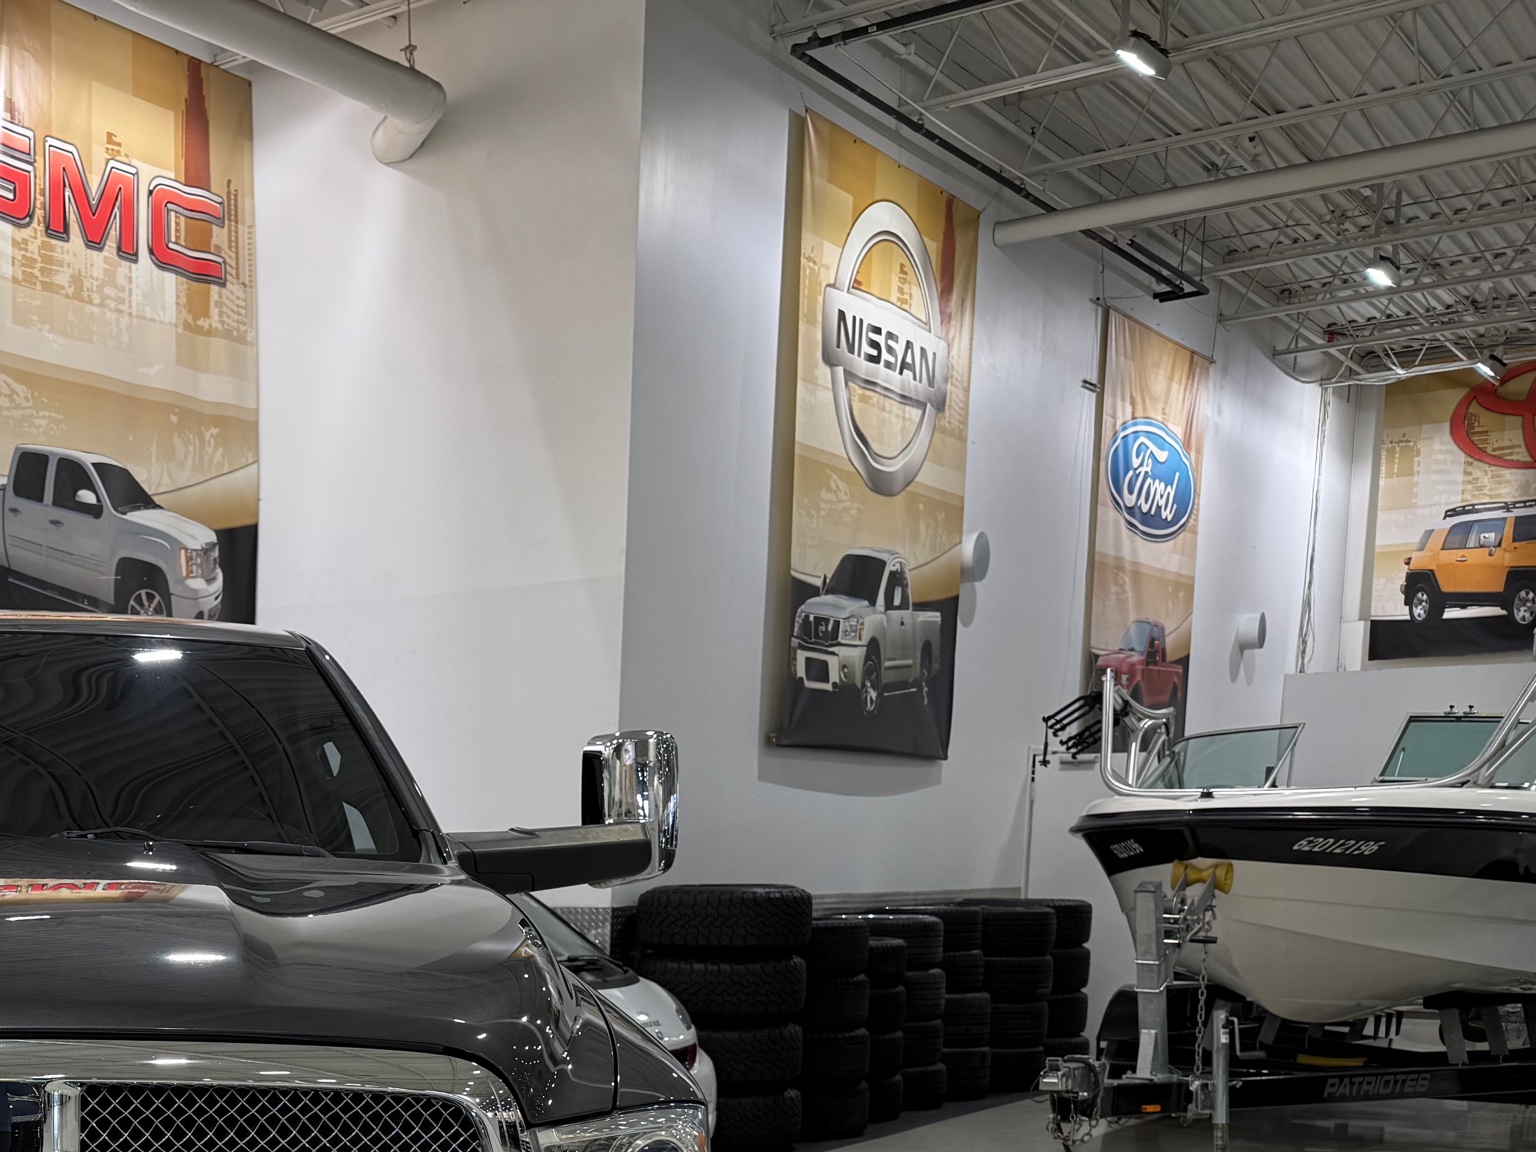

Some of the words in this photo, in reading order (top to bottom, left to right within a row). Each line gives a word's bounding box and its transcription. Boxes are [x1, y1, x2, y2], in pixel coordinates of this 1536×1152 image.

[836, 308, 937, 390] NISSAN
[1123, 435, 1180, 522] Ford
[1292, 836, 1386, 855] 62012196
[1323, 1073, 1431, 1097] PATRIOTES
